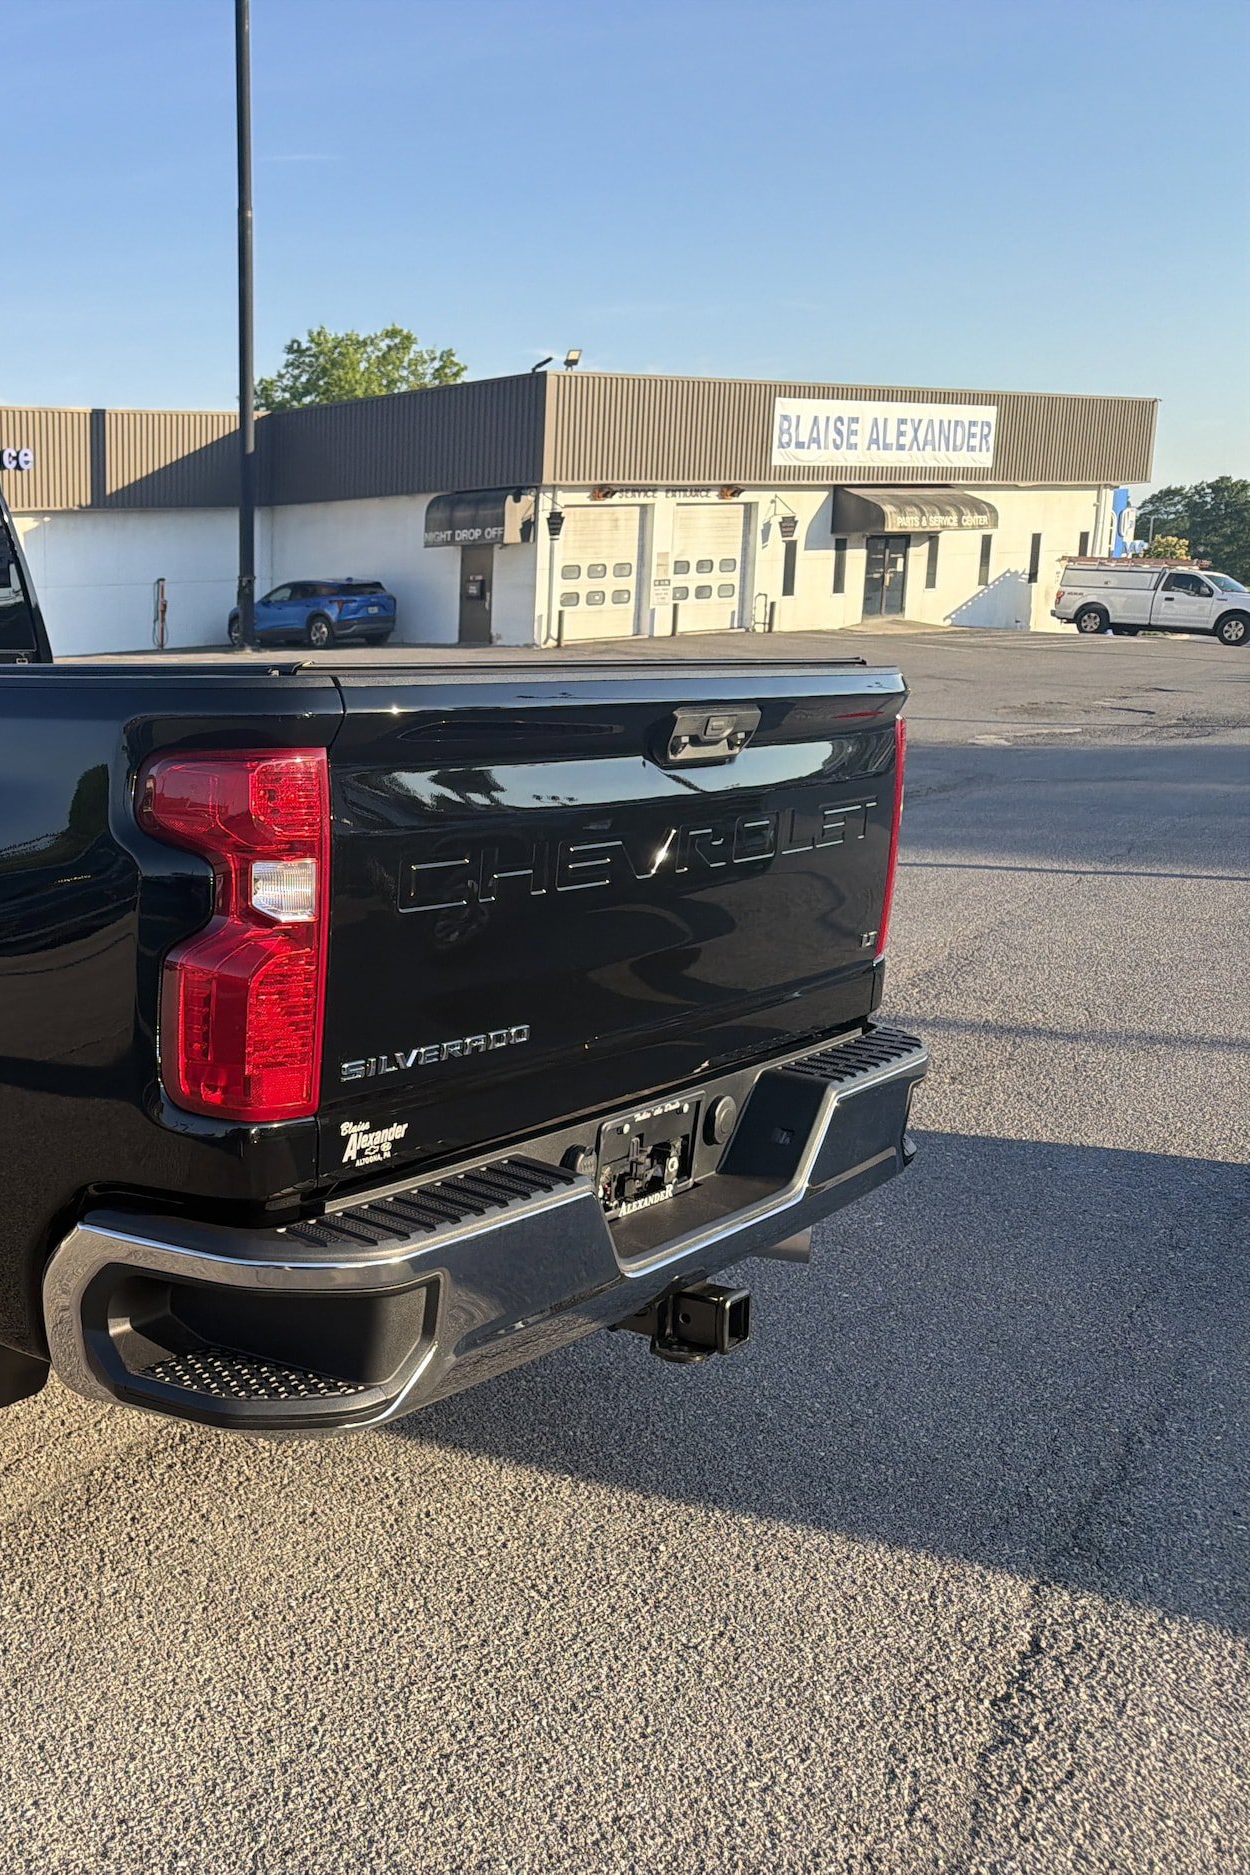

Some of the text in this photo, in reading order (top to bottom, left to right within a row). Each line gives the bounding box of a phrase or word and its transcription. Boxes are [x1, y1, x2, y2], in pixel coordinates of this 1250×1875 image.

[777, 414, 993, 453] BLAISE ALEXANDER
[618, 487, 712, 499] SERVICE ENTRANCE
[897, 515, 988, 527] PARTS & SERVICE CENTER
[455, 529, 482, 541] DROP
[484, 527, 504, 539] OFF
[396, 794, 878, 914] CHEVROLET
[860, 930, 878, 948] LT
[339, 1024, 531, 1083] SILVERADO
[340, 1121, 371, 1136] Blaise
[342, 1122, 409, 1163] Alexander
[355, 1151, 391, 1167] ALTOONA, PA
[618, 1184, 674, 1218] ALEXANDER
